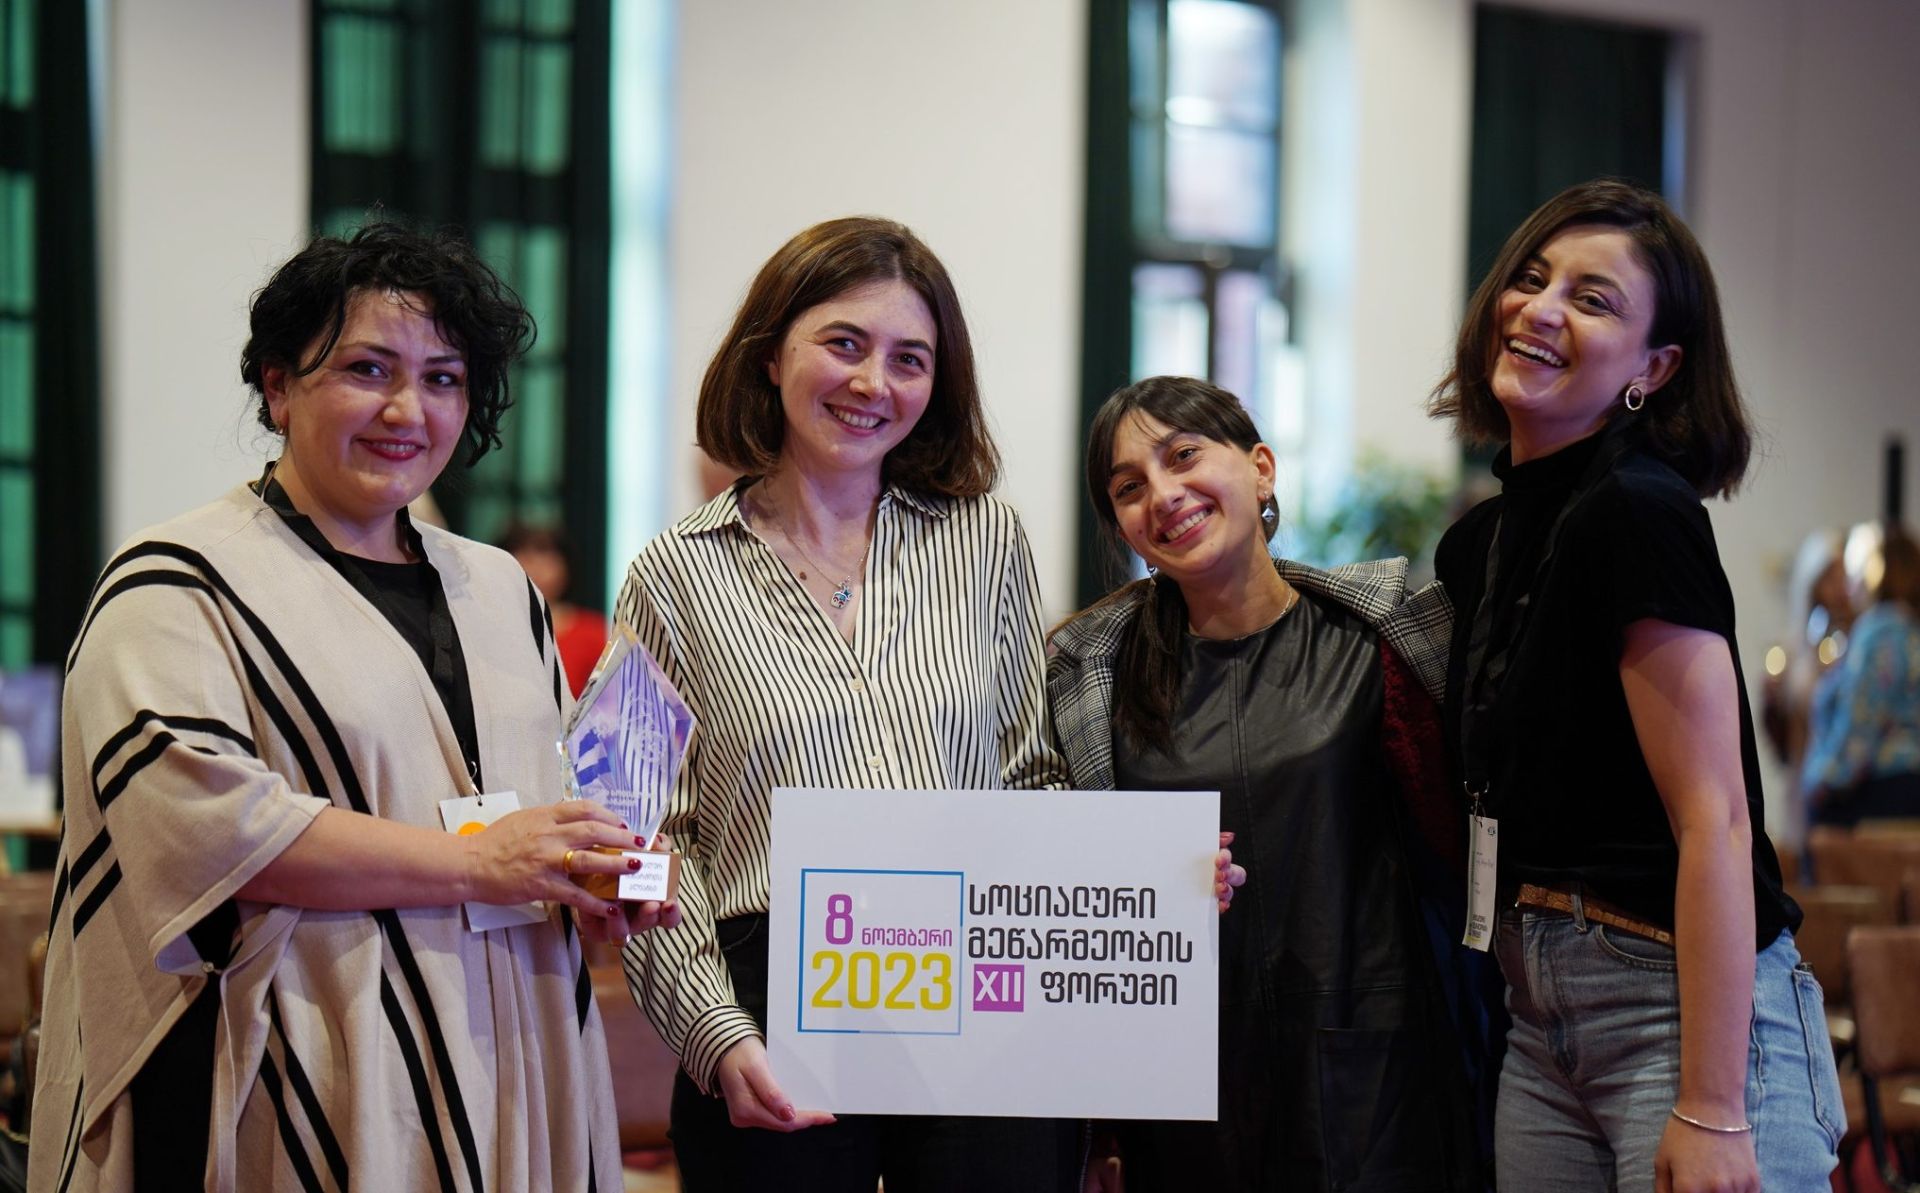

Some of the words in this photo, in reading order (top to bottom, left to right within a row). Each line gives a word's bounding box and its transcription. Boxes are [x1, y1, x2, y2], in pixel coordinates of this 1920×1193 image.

[825, 893, 854, 946] 8
[861, 927, 953, 947] ნოემბერი
[969, 884, 1156, 919] სოციალური
[968, 926, 1193, 963] მეწარმეობის
[811, 950, 953, 1012] 2023
[976, 970, 1021, 1002] XII
[1040, 971, 1178, 1006] ფორუმი
